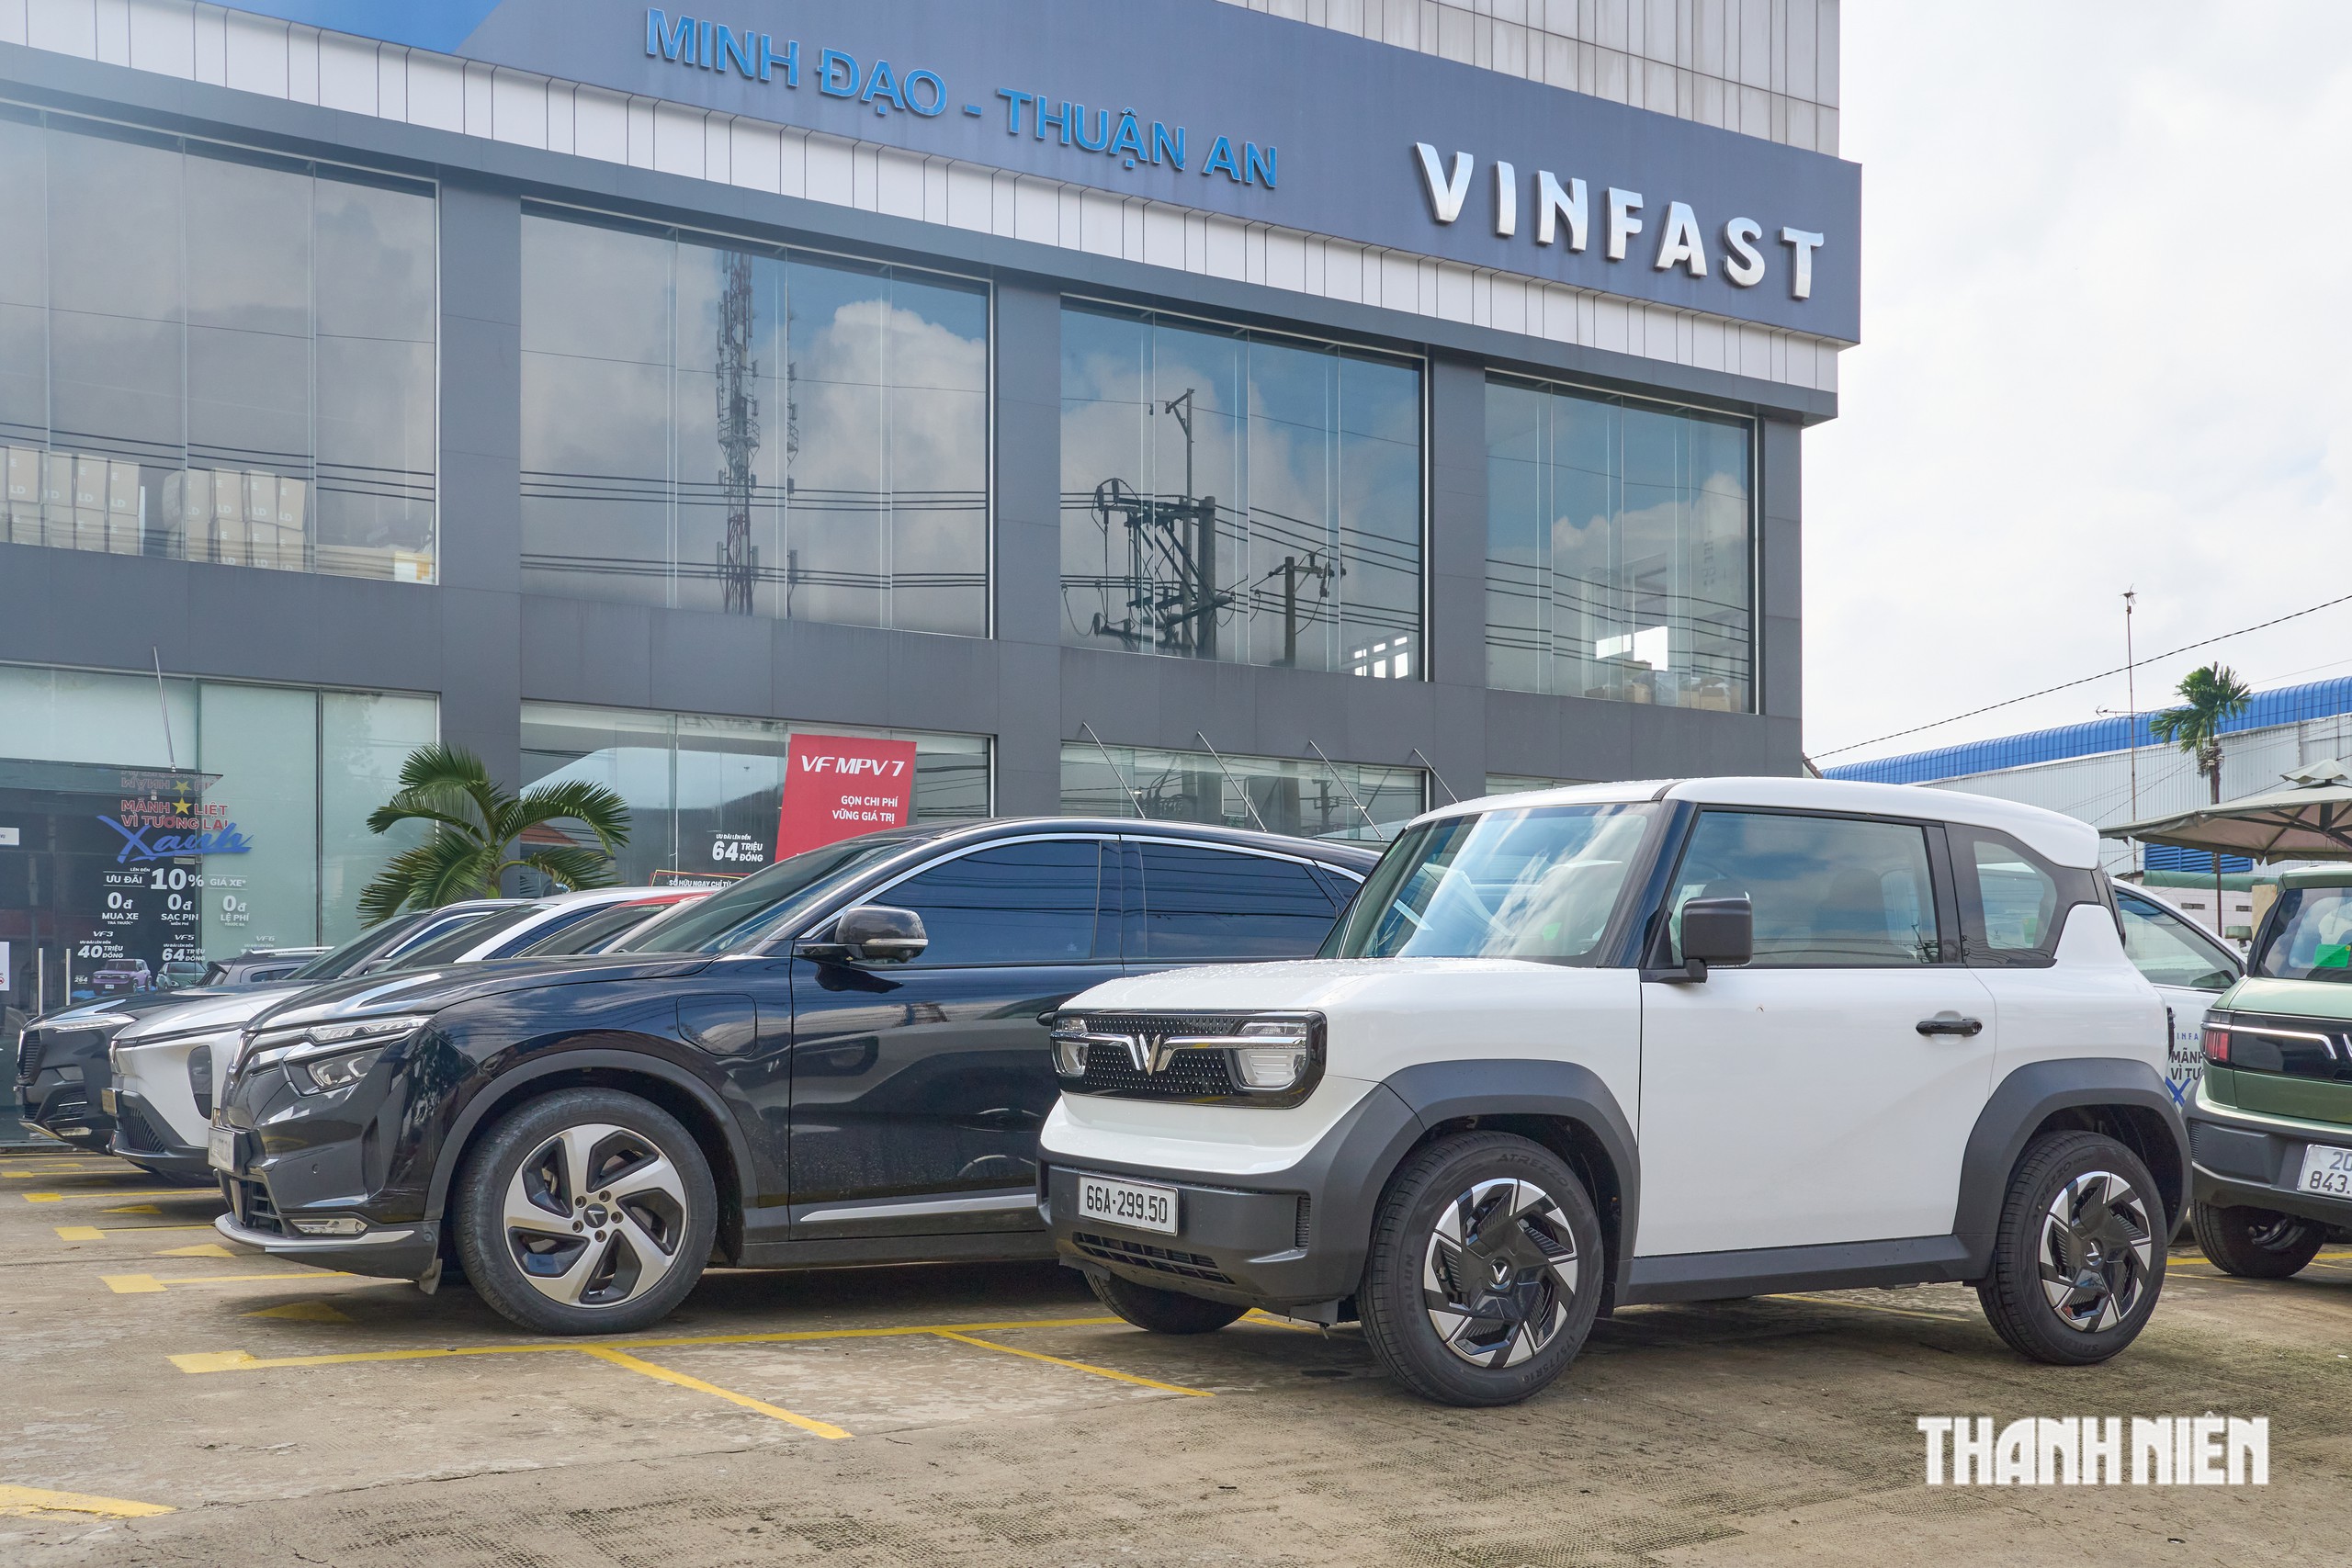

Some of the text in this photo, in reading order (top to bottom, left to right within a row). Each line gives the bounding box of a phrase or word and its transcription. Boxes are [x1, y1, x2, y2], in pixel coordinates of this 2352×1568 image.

[645, 7, 800, 88] MINH
[817, 47, 948, 118] ĐẠO
[999, 86, 1187, 172] THUẬN
[1203, 134, 1278, 188] AN
[1415, 141, 1825, 300] VINFAST
[801, 755, 905, 776] VF MPV 7
[120, 797, 229, 818] MÃNH LIỆT
[841, 795, 899, 807] GỌN CHI PHÍ
[120, 811, 139, 828] VÌ
[141, 815, 199, 829] TƯƠNG
[832, 807, 895, 824] VỮNG GIÁ TRỊ
[96, 815, 254, 863] Xanh
[712, 840, 763, 862] 64 TRIỆU
[106, 874, 121, 884] ƯU
[123, 874, 142, 884] ĐÃI
[151, 867, 204, 890] 10%
[209, 877, 227, 886] GIÁ
[161, 913, 180, 922] SẠC
[220, 912, 250, 923] LỆ PHÍ
[77, 944, 123, 958] 40 TRIỆU
[162, 947, 185, 962] 64
[2177, 1032, 2199, 1041] INFA
[2170, 1064, 2182, 1080] VÌ
[1497, 1153, 1568, 1187] ATREZZO
[1087, 1185, 1168, 1224] 66A-299.50
